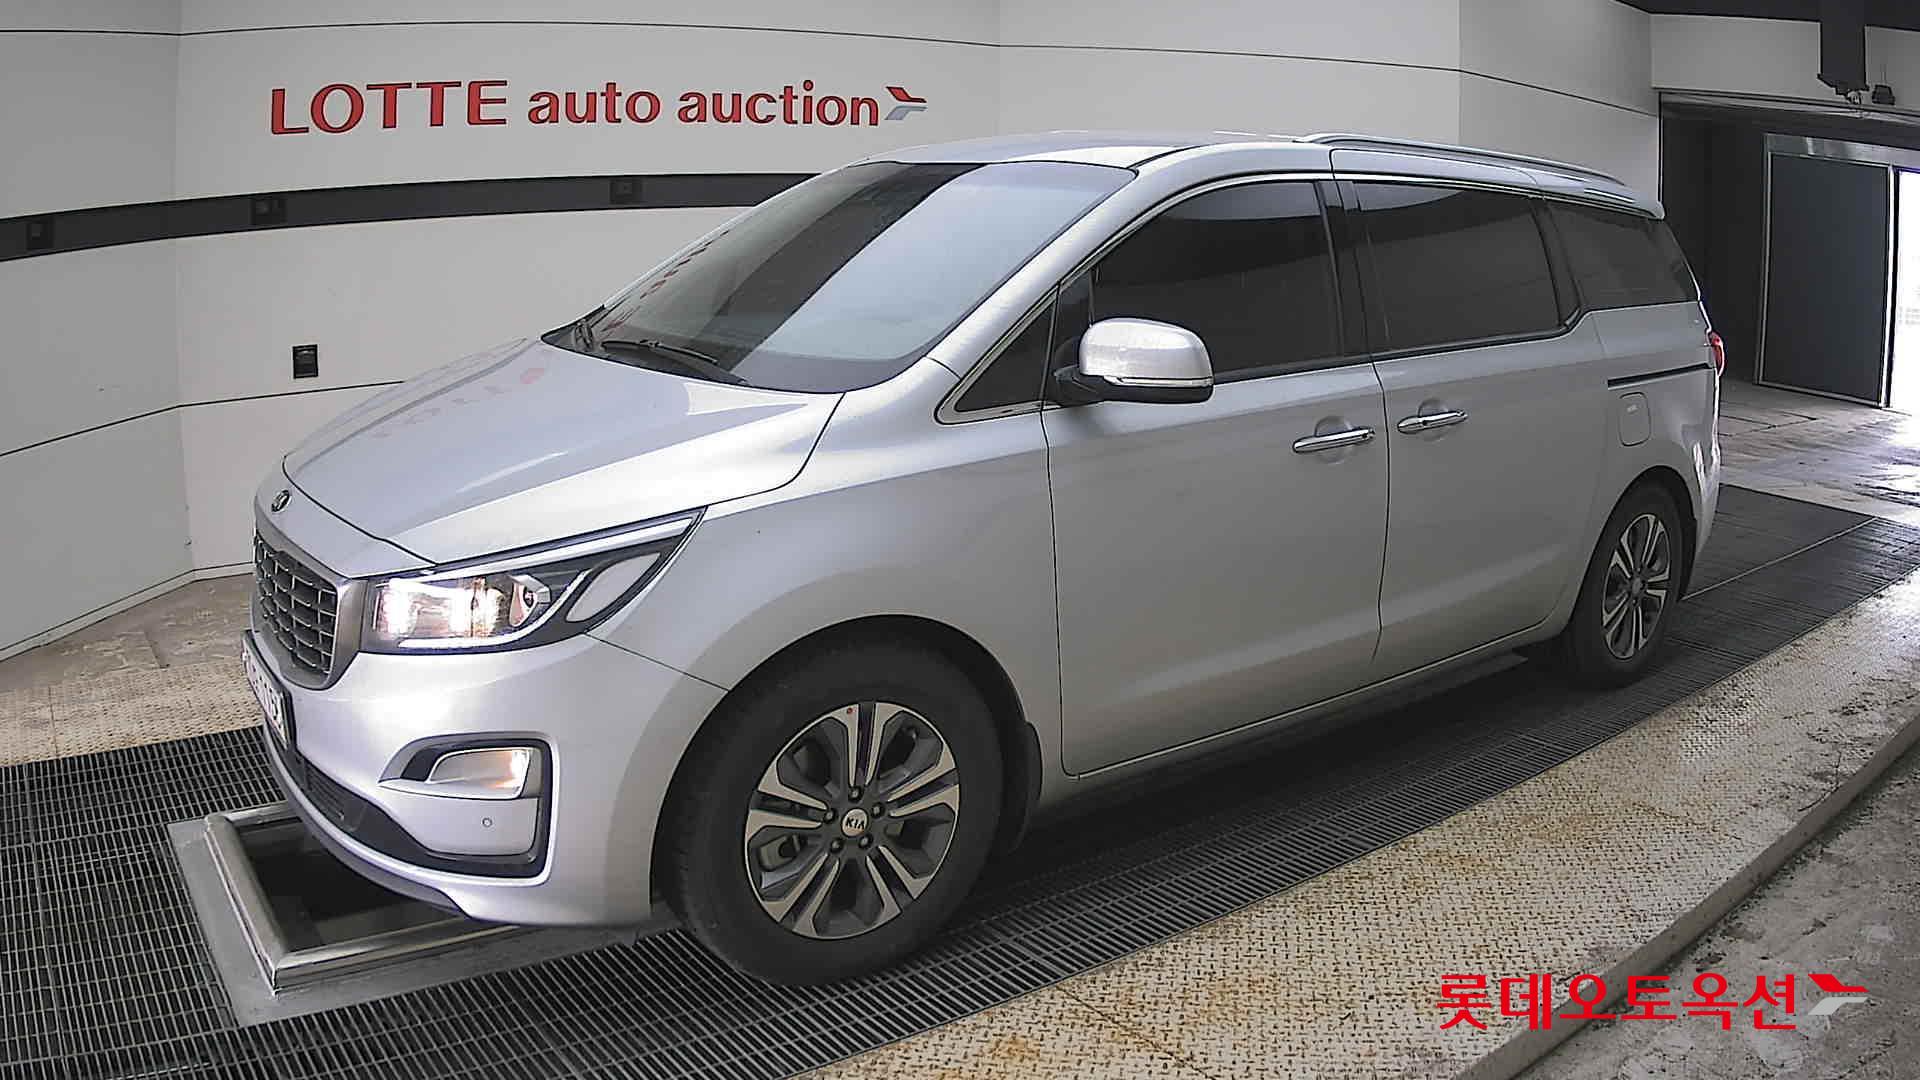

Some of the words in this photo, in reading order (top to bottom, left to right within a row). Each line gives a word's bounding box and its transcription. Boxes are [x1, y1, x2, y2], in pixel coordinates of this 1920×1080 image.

[271, 80, 507, 135] LOTTE
[528, 82, 661, 124] auto
[677, 80, 880, 126] auction
[845, 817, 866, 830] KIA
